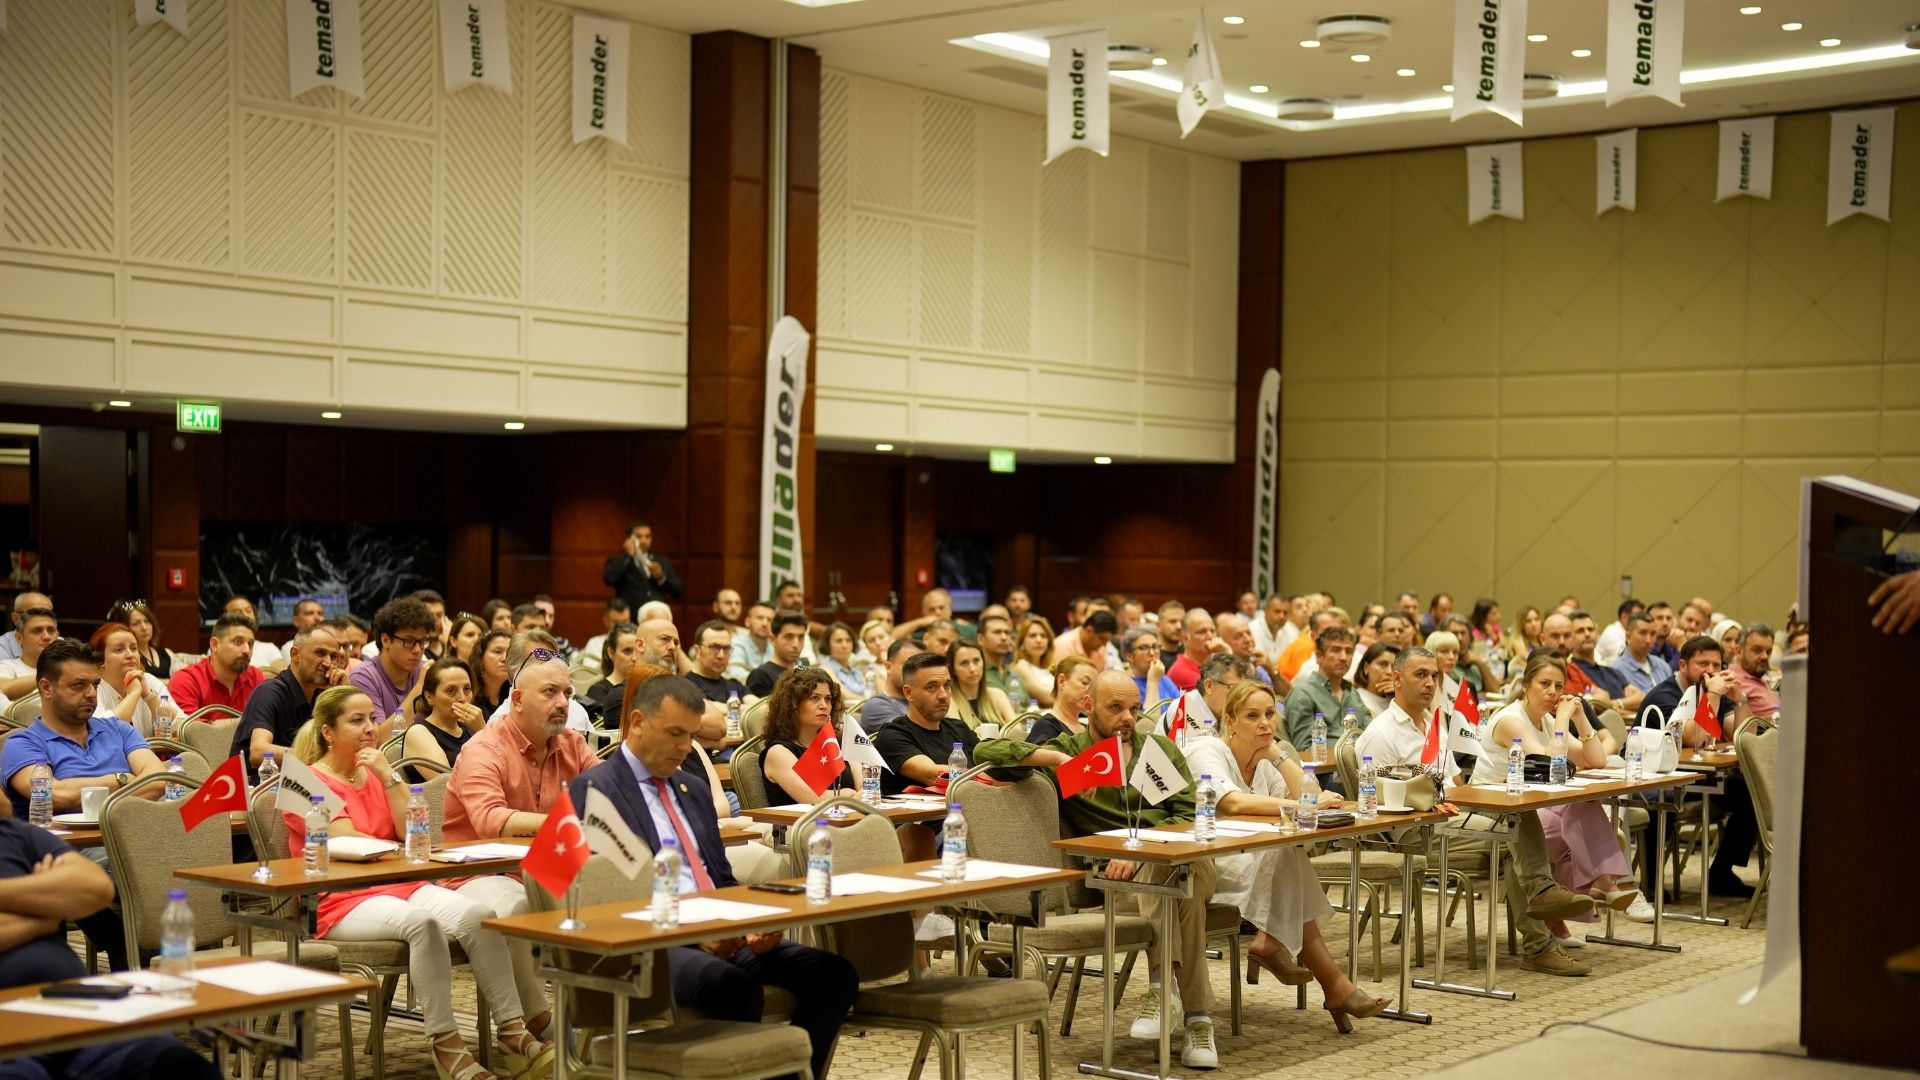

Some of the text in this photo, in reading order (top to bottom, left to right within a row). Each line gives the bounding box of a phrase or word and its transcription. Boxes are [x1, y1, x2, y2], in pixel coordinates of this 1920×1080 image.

[312, 0, 334, 77] temad
[466, 4, 482, 77] temader
[1476, 0, 1497, 101] temader
[1633, 0, 1654, 85] temad
[590, 33, 607, 129] temader
[1069, 48, 1085, 140] temader
[1739, 131, 1750, 190] temader
[1850, 124, 1869, 206] temader
[183, 408, 218, 428] EXIT
